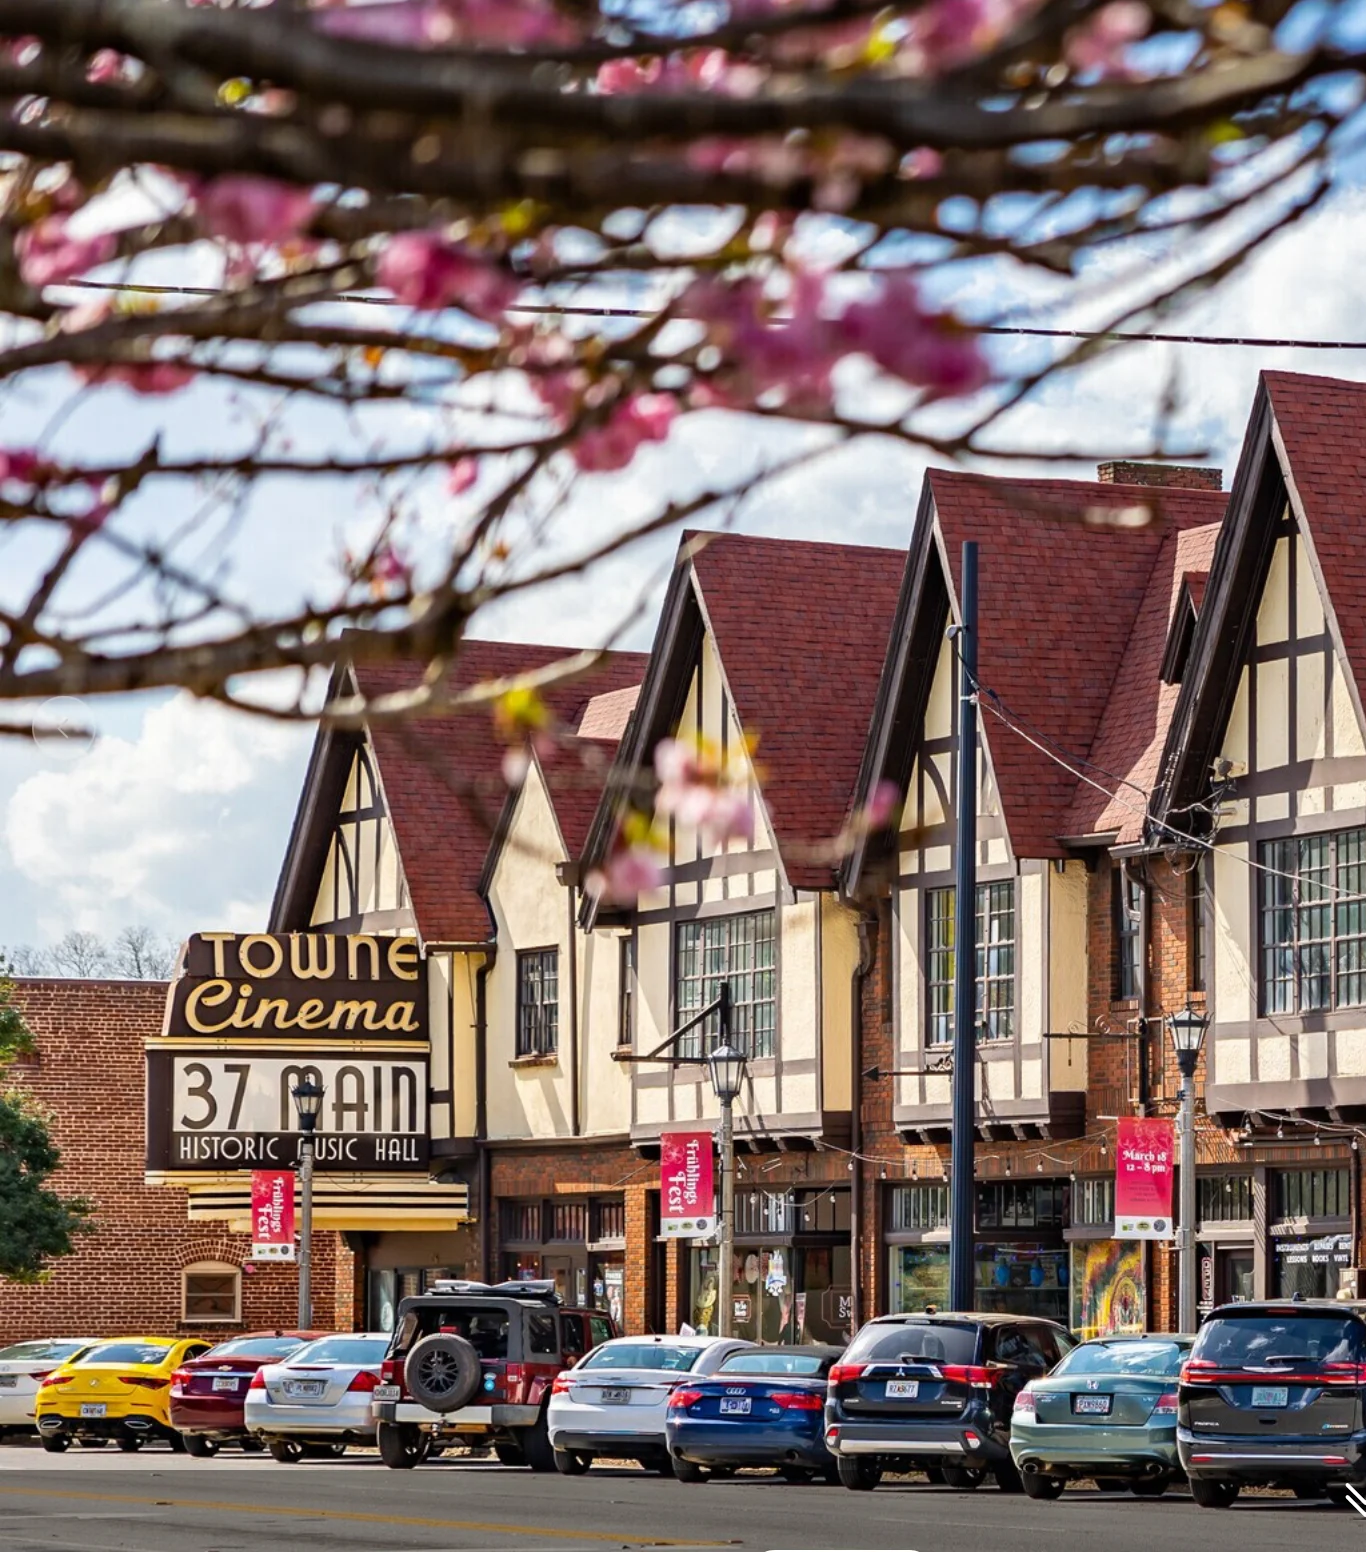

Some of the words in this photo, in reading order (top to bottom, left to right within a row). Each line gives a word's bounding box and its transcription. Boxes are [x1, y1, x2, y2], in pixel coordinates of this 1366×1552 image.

[201, 931, 419, 981] TOWNE
[184, 978, 420, 1034] Cinema
[181, 1062, 251, 1130] 37
[180, 1136, 279, 1160] HISTORIC
[375, 1138, 420, 1162] HALL
[1122, 1149, 1155, 1161] March
[1157, 1151, 1167, 1162] 18
[1126, 1163, 1136, 1172] 12
[1143, 1162, 1151, 1172] 8
[1151, 1165, 1166, 1175] pm
[668, 1170, 687, 1214] Fest
[257, 1203, 273, 1240] Fest
